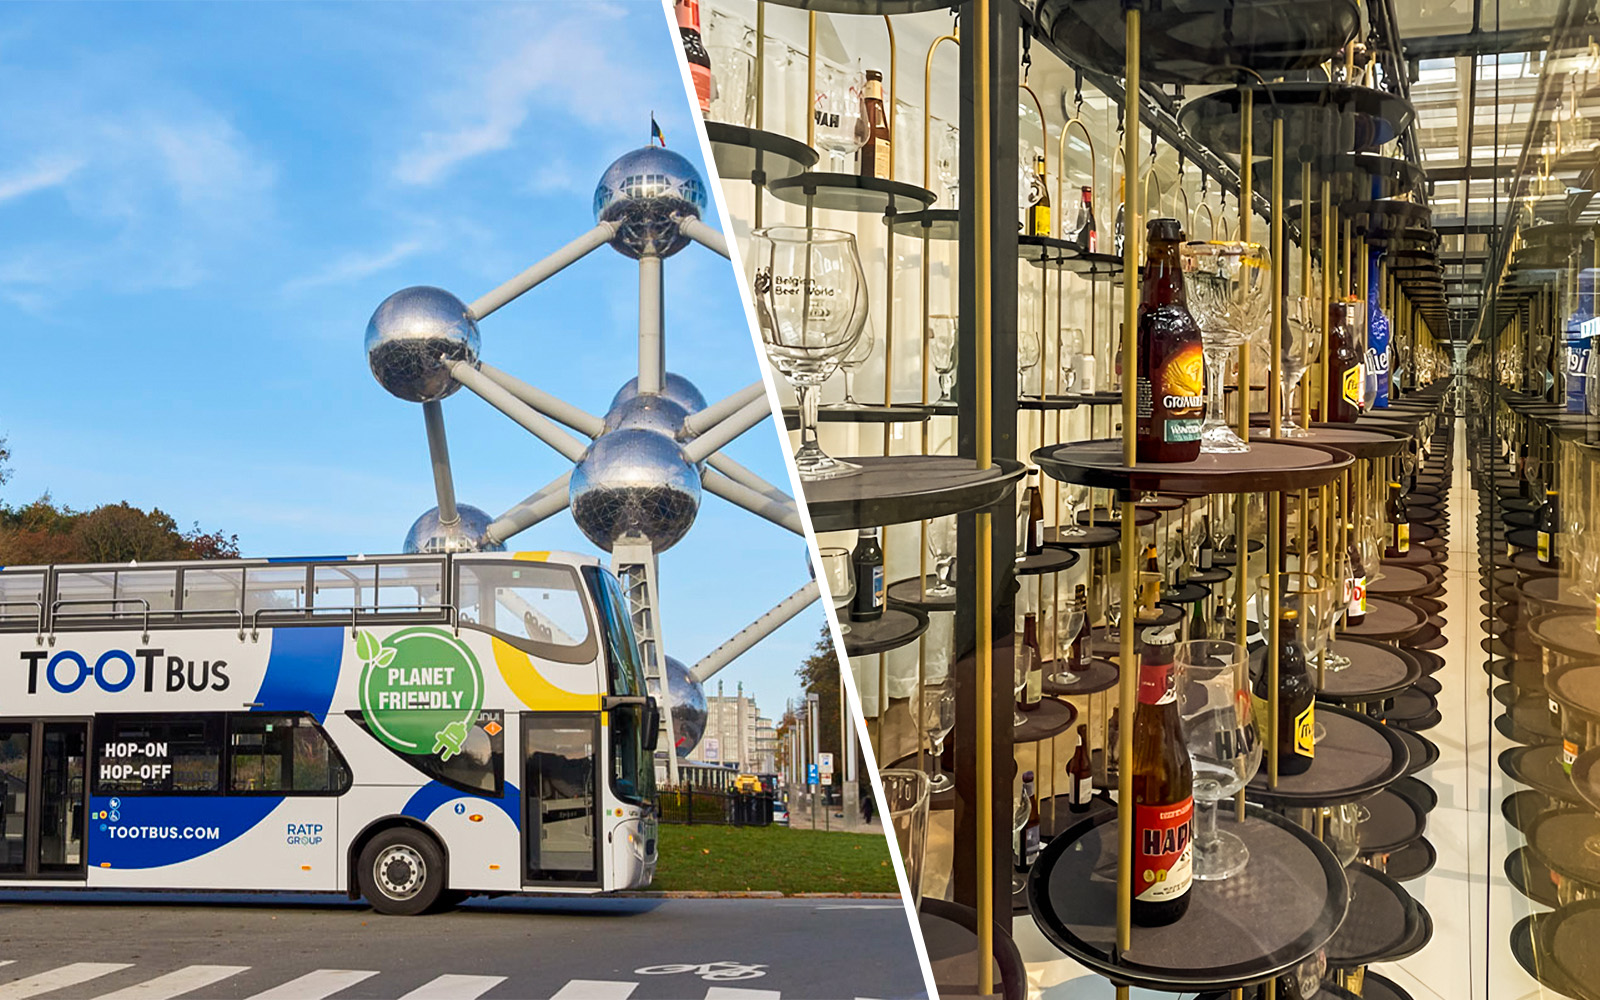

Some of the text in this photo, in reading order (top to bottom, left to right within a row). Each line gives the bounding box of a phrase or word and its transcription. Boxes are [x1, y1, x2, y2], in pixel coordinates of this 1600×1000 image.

[775, 286, 800, 296] Beer
[388, 667, 455, 686] PLANET
[378, 690, 464, 710] FRIENDLY
[105, 742, 168, 757] HOP-ON
[100, 764, 172, 779] HOP-OFF
[108, 826, 220, 839] TOOTBUS.COM
[287, 823, 323, 835] RATP
[286, 835, 323, 845] GROUP
